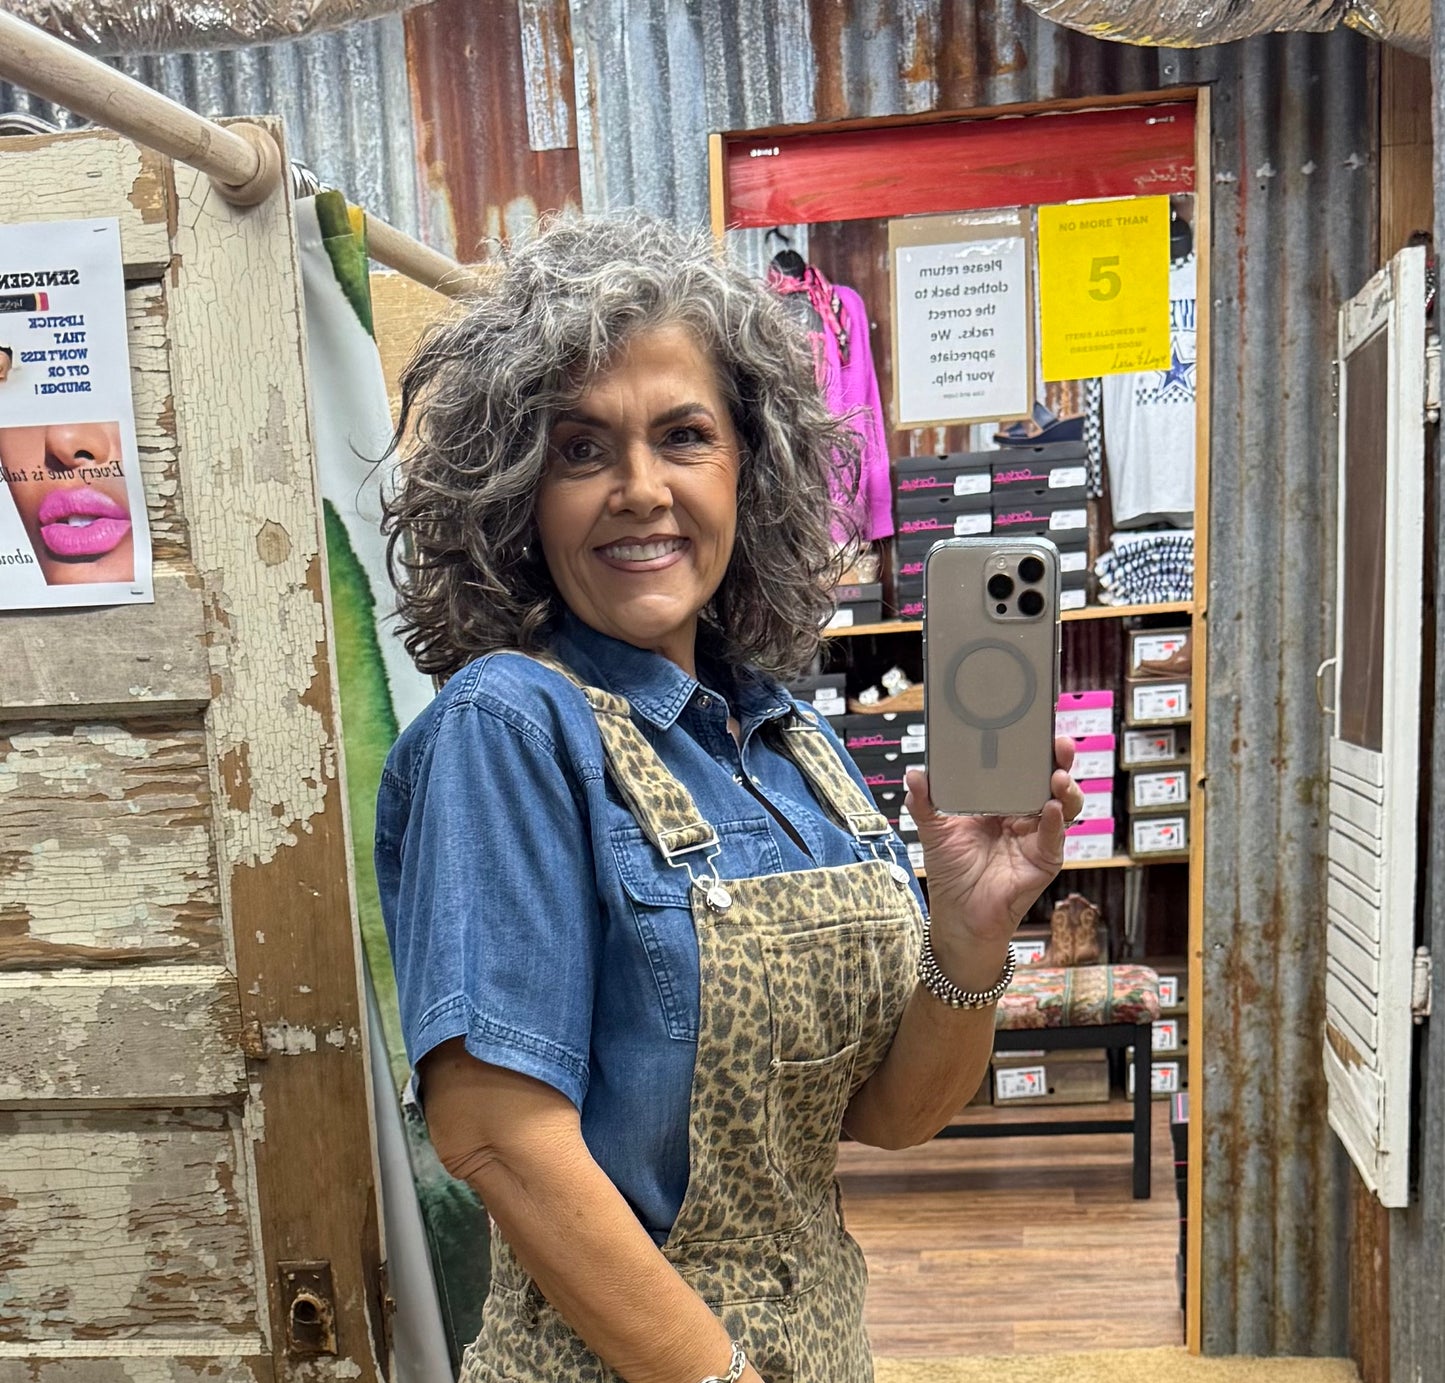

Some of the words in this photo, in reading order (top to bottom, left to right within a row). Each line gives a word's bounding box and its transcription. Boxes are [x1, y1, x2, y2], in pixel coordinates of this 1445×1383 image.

[1058, 222, 1076, 232] NO
[1079, 218, 1113, 229] MORE
[1117, 215, 1149, 227] THAN
[1088, 255, 1122, 302] 5
[1094, 327, 1135, 339] ALLOWED
